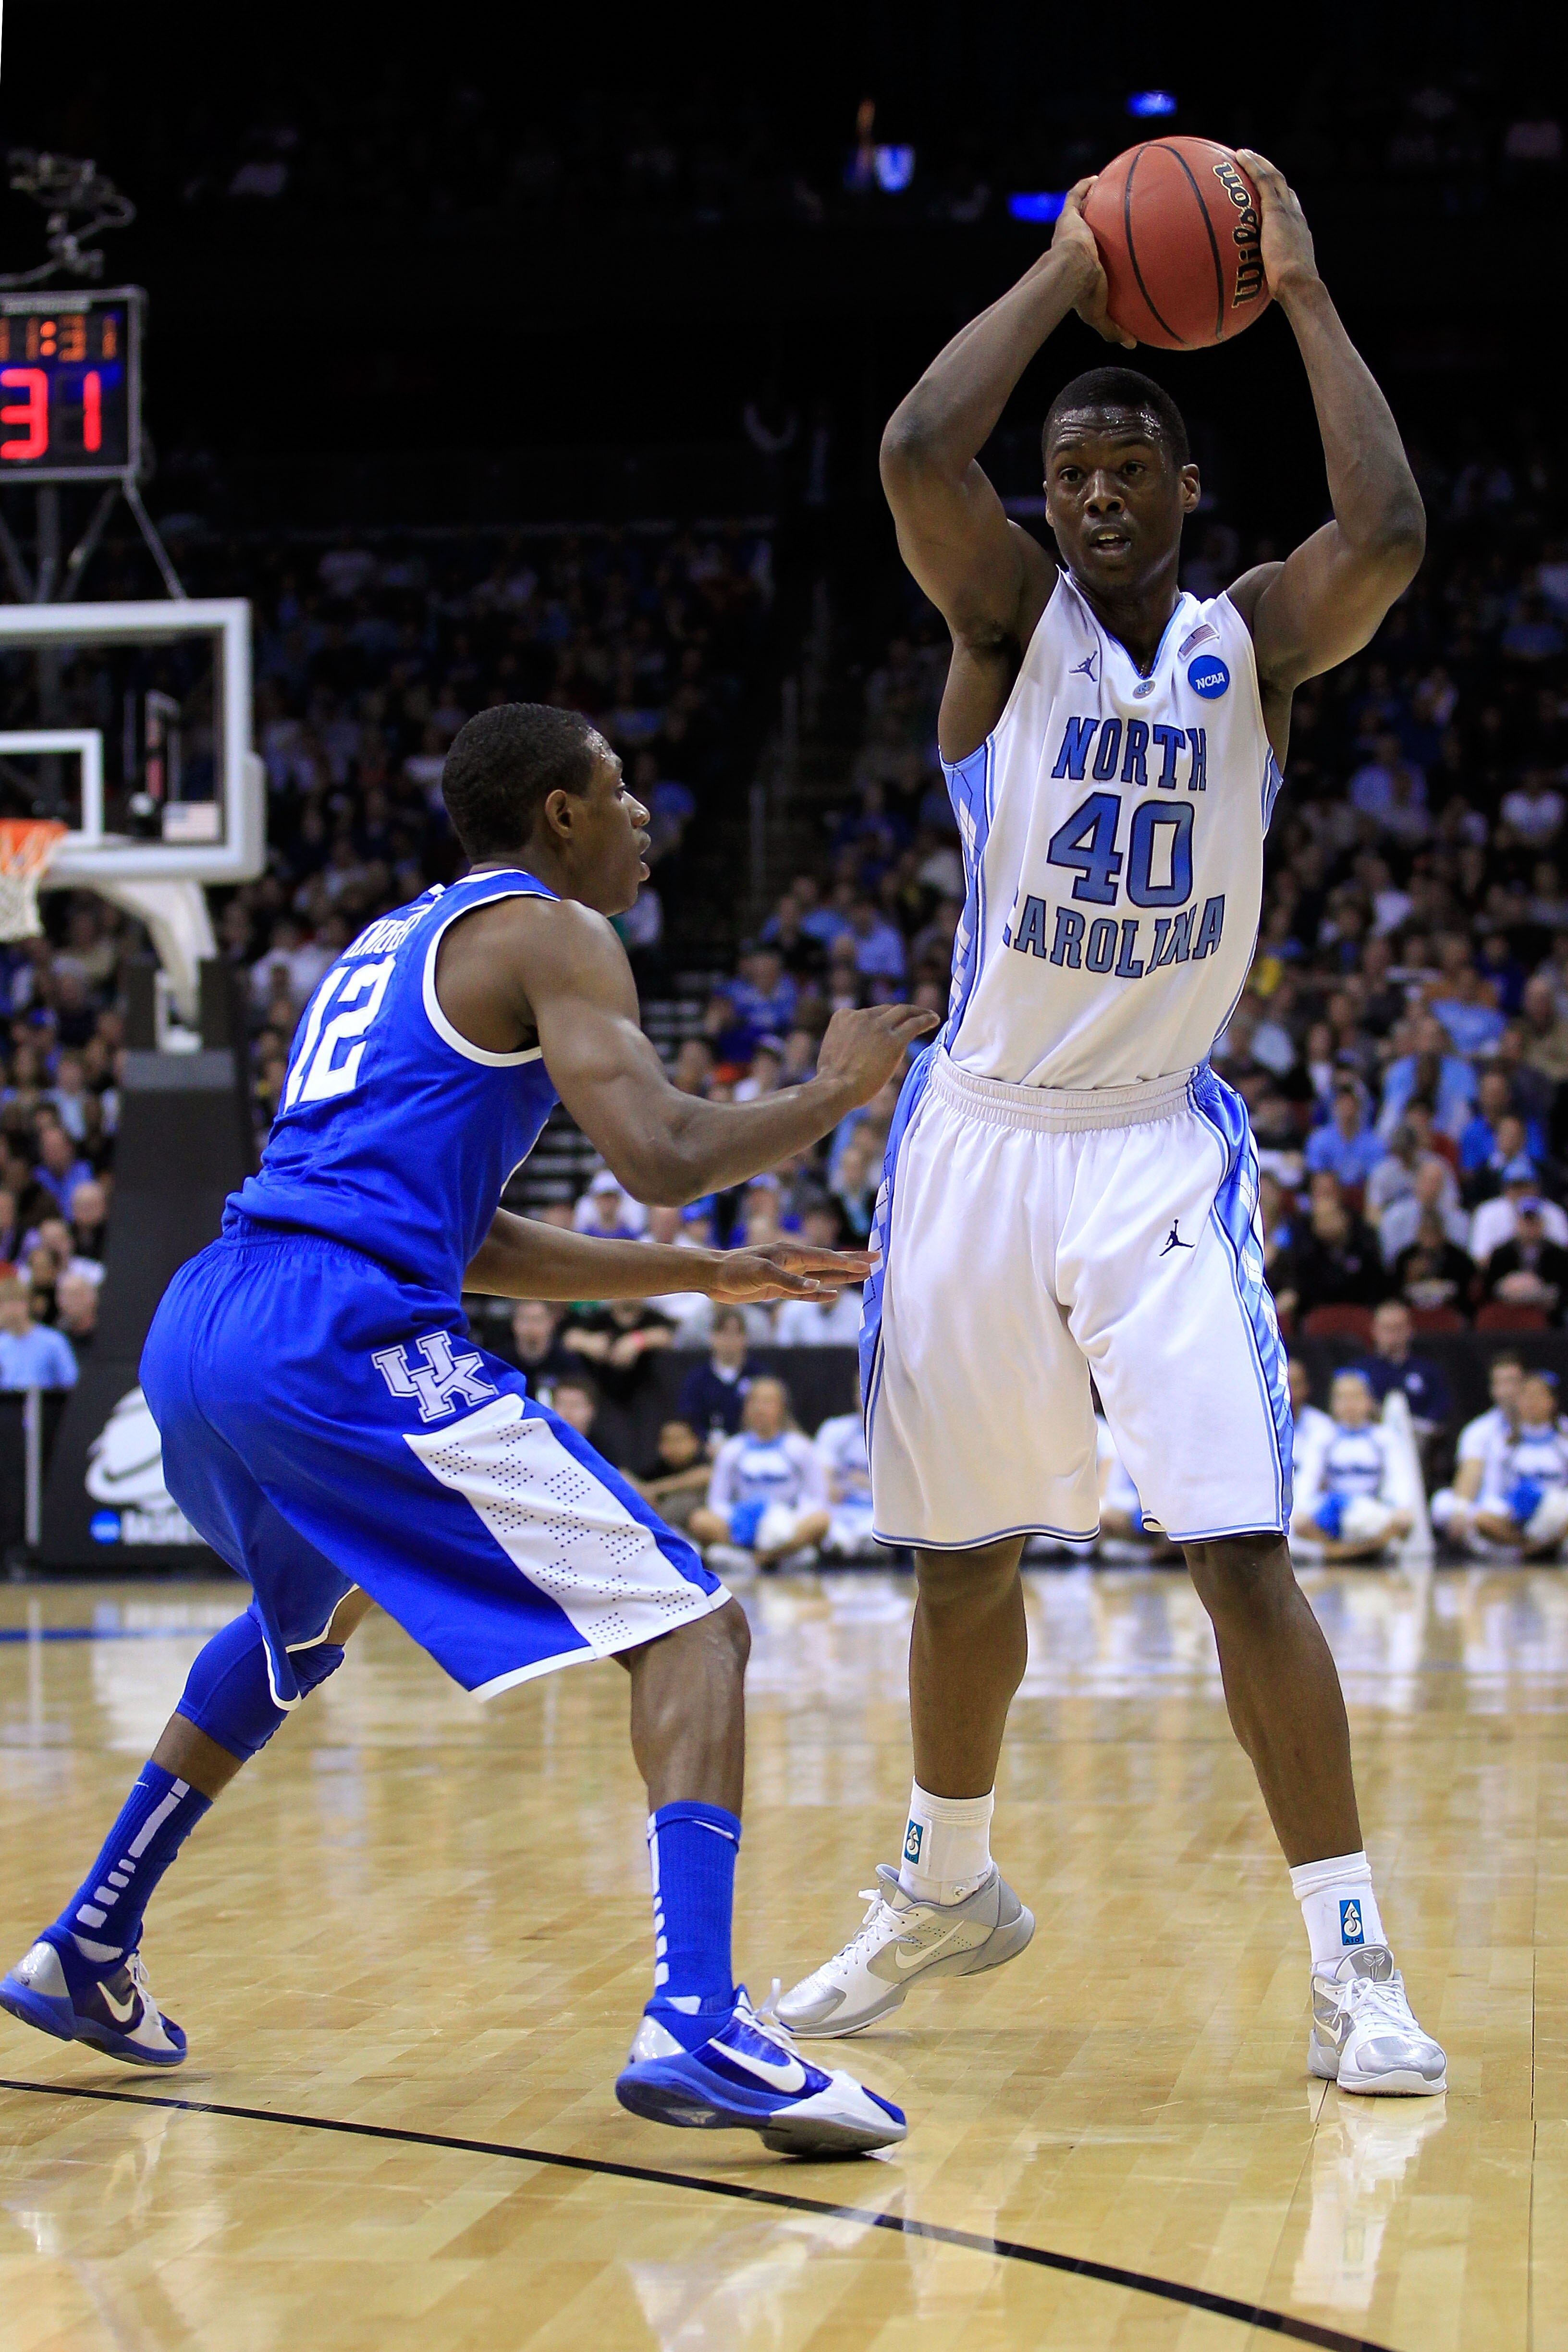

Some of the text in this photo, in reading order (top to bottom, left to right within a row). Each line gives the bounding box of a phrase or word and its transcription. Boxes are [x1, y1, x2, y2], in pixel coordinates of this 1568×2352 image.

[1212, 161, 1264, 309] Wilson
[0, 368, 102, 459] 31
[1195, 672, 1225, 690] NCAA
[1051, 717, 1206, 791] NORTH
[1047, 792, 1194, 907] 40
[1003, 887, 1225, 979] AROLINA
[283, 953, 396, 1115] 12
